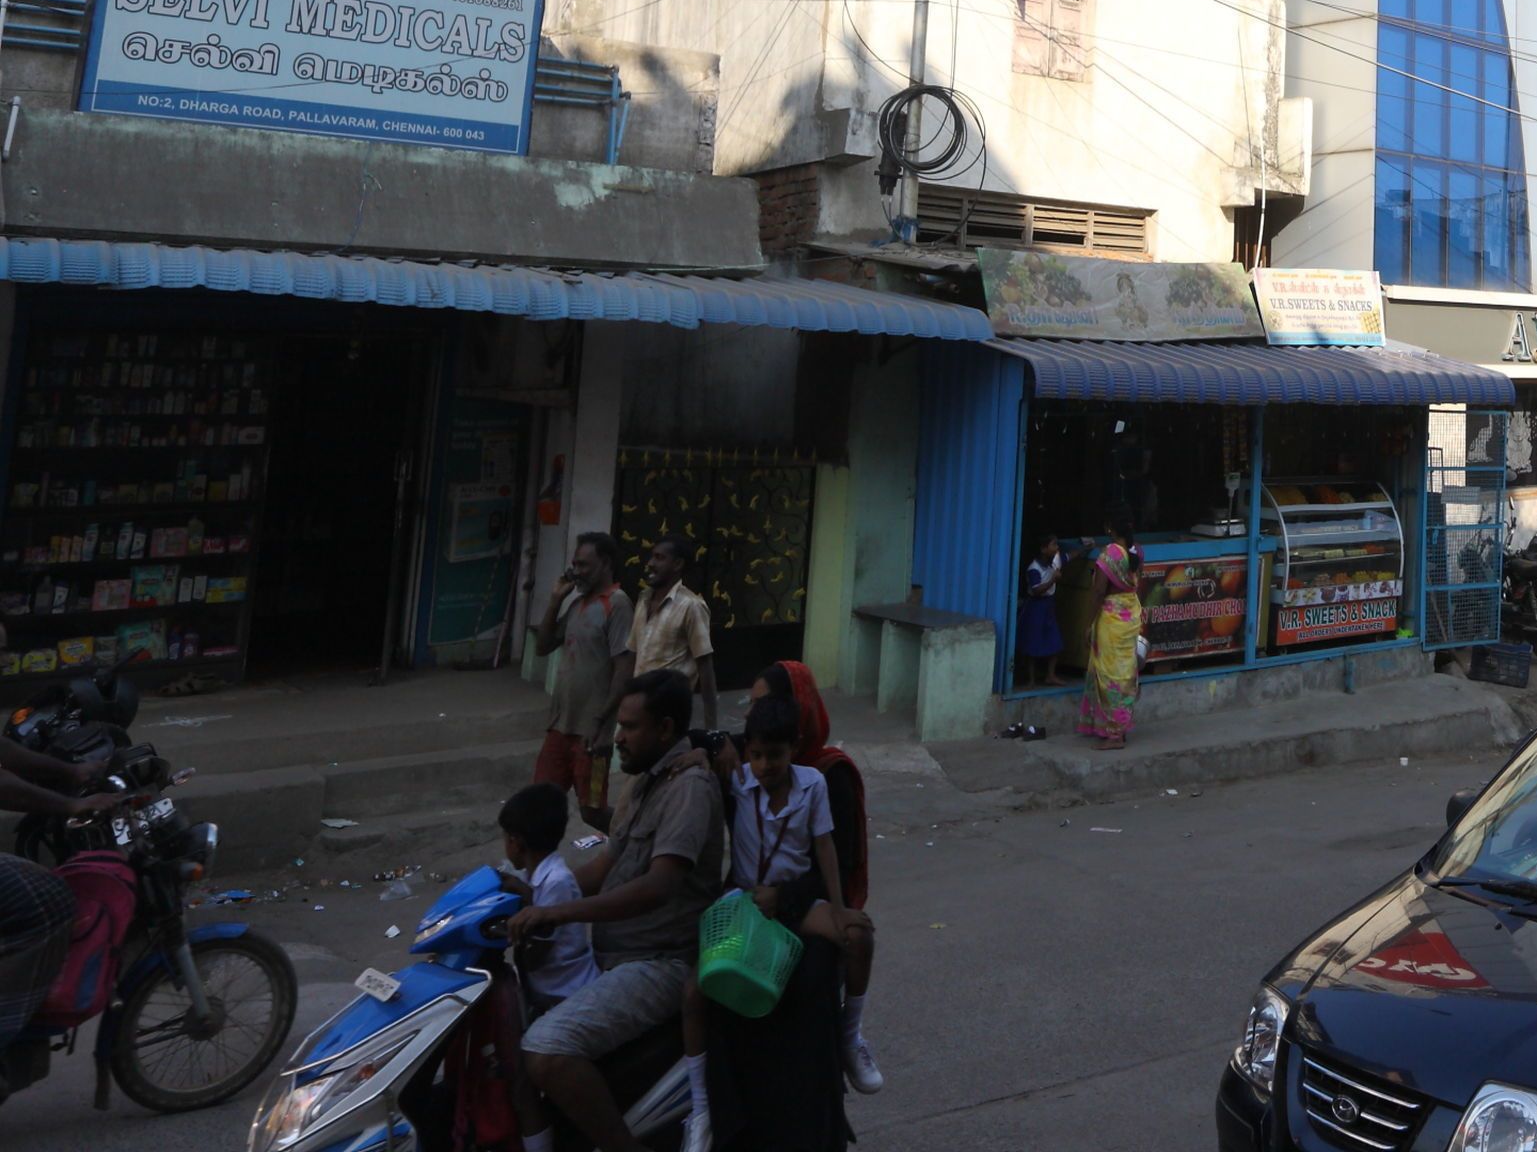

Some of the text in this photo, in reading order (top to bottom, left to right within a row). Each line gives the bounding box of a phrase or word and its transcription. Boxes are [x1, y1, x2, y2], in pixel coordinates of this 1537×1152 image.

[122, 31, 509, 102] செல்வி மெடிகல்ஸ்
[138, 94, 176, 111] NO:2,
[180, 99, 238, 116] DHARGA
[243, 105, 285, 121] ROAD,
[288, 110, 379, 131] PALLAVARAM,
[443, 126, 463, 139] 600
[465, 129, 485, 141] 043
[1328, 302, 1337, 311] &
[1338, 299, 1373, 312] SNACKS
[1304, 604, 1347, 627] SWEETS
[1350, 601, 1358, 621] &
